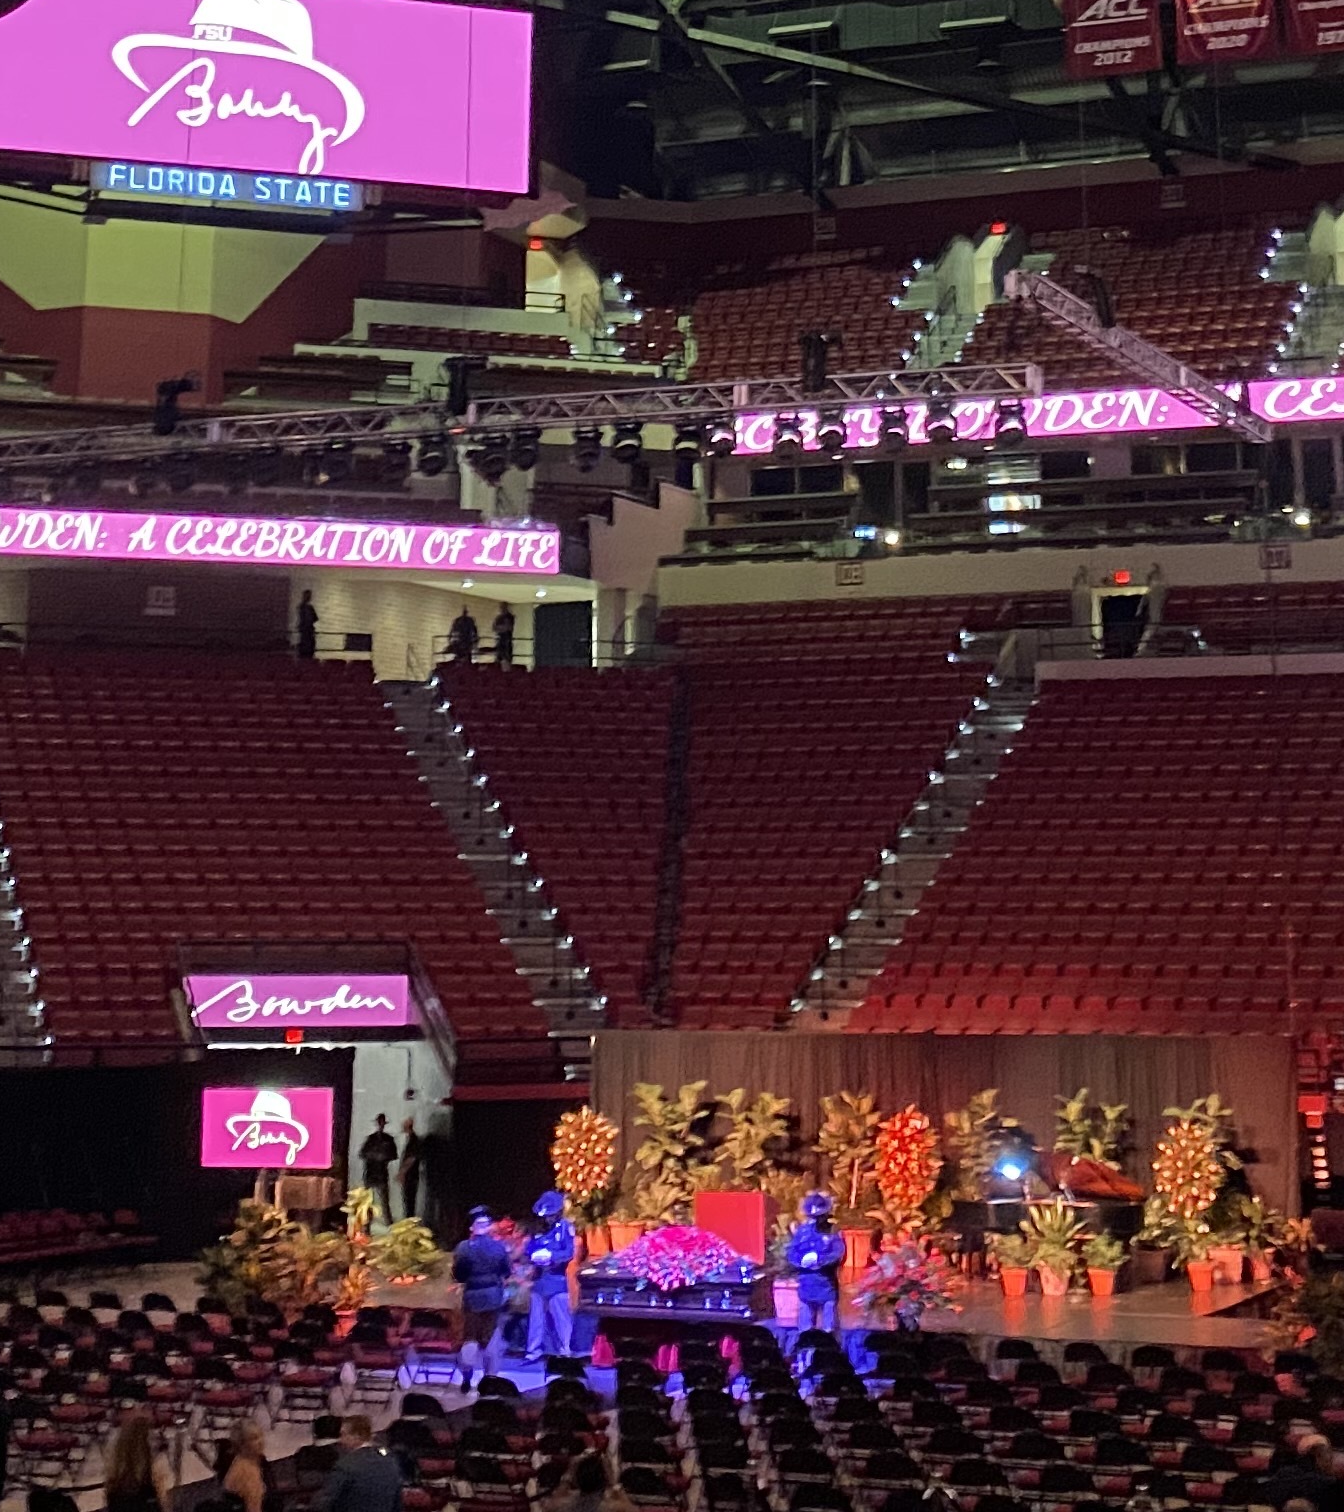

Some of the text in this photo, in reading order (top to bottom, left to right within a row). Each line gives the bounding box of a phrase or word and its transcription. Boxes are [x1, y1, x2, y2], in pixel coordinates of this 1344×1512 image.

[192, 24, 233, 42] FSU
[1093, 50, 1134, 66] 2012
[109, 164, 351, 206] FLORIDA STATE
[127, 516, 157, 552] A
[164, 517, 416, 563] CELEBRATION
[422, 528, 475, 565] OF
[472, 531, 556, 569] LIFE
[190, 979, 396, 1023] Bowden
